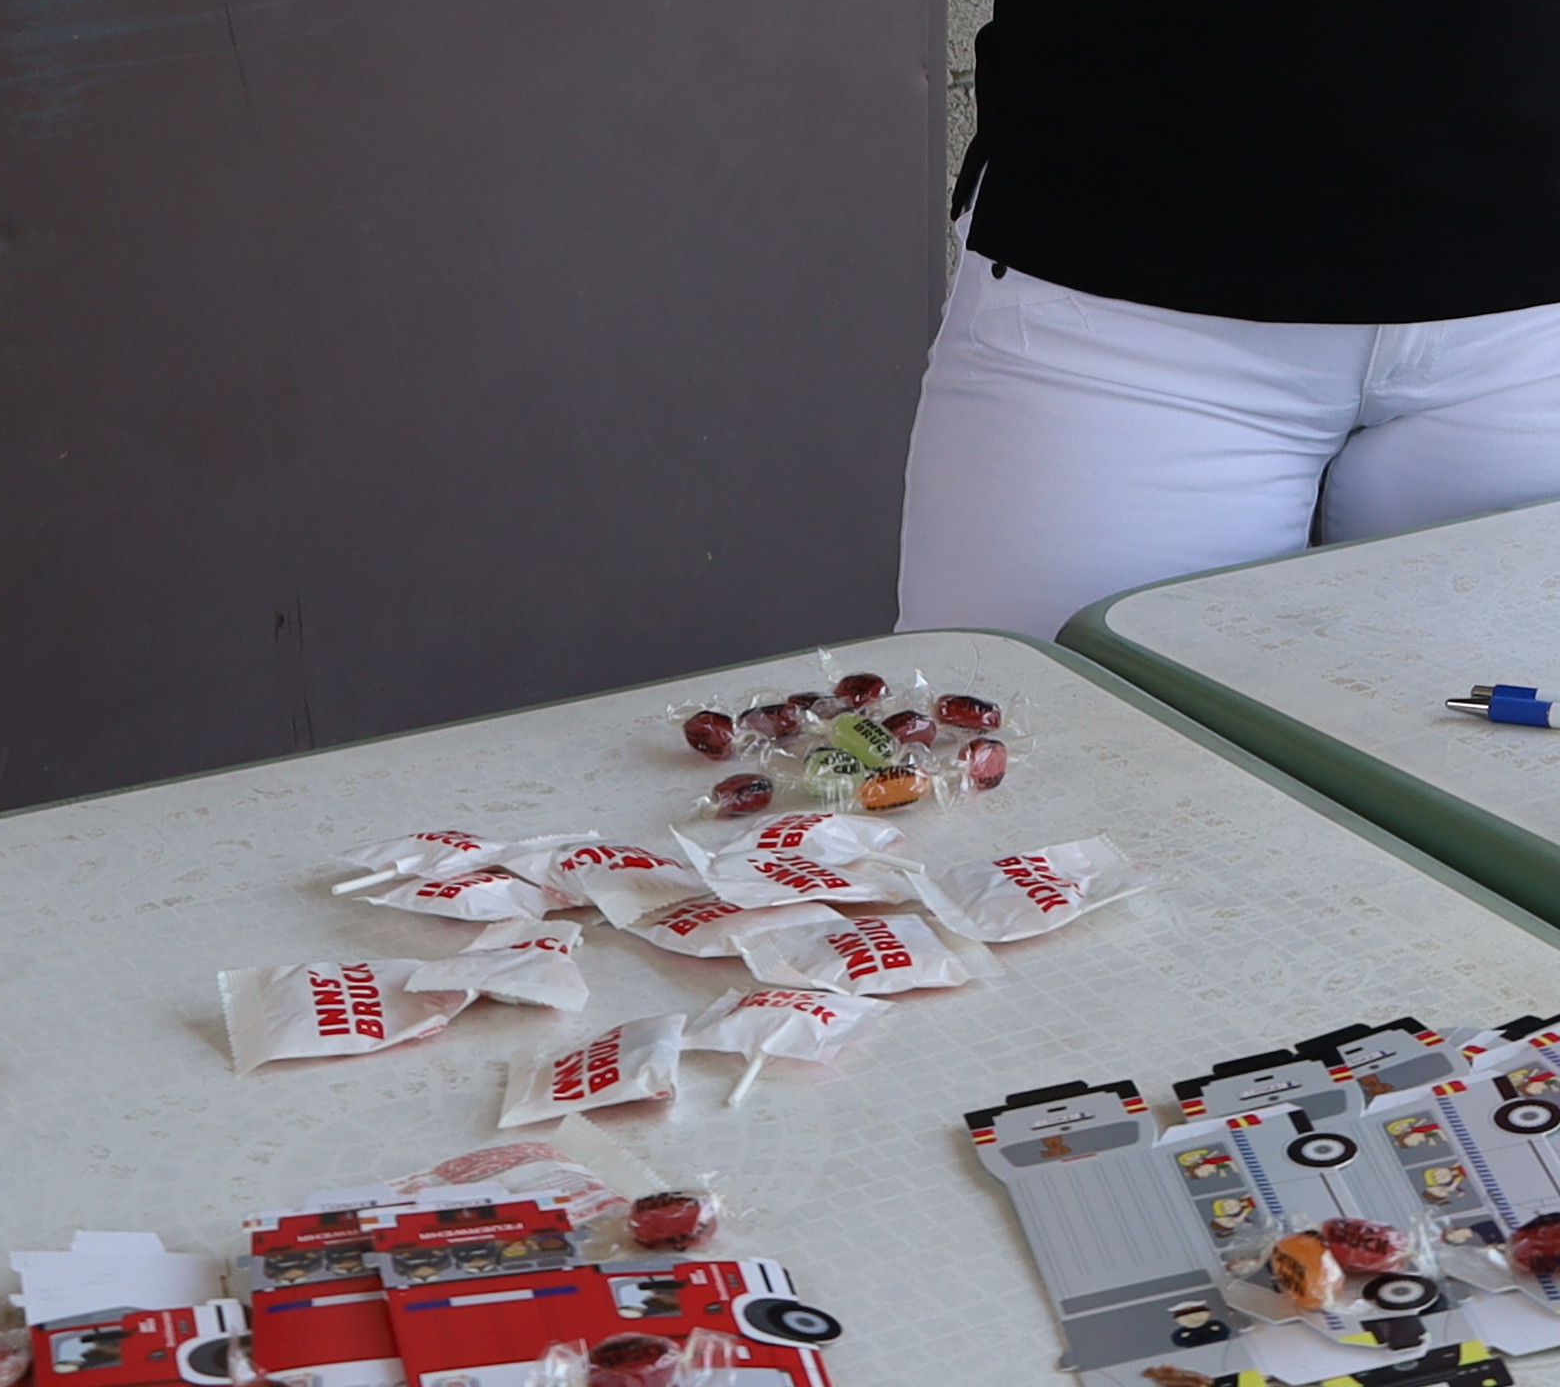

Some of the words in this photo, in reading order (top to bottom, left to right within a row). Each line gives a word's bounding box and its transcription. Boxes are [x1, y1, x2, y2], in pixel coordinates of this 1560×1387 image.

[746, 858, 820, 894] INNS'
[771, 849, 851, 891] BRUC
[991, 856, 1069, 914] BRUCK
[667, 902, 744, 937] BRU
[824, 932, 879, 981] INNS'
[308, 969, 352, 1037] INNS'
[341, 962, 385, 1040] BRUCK
